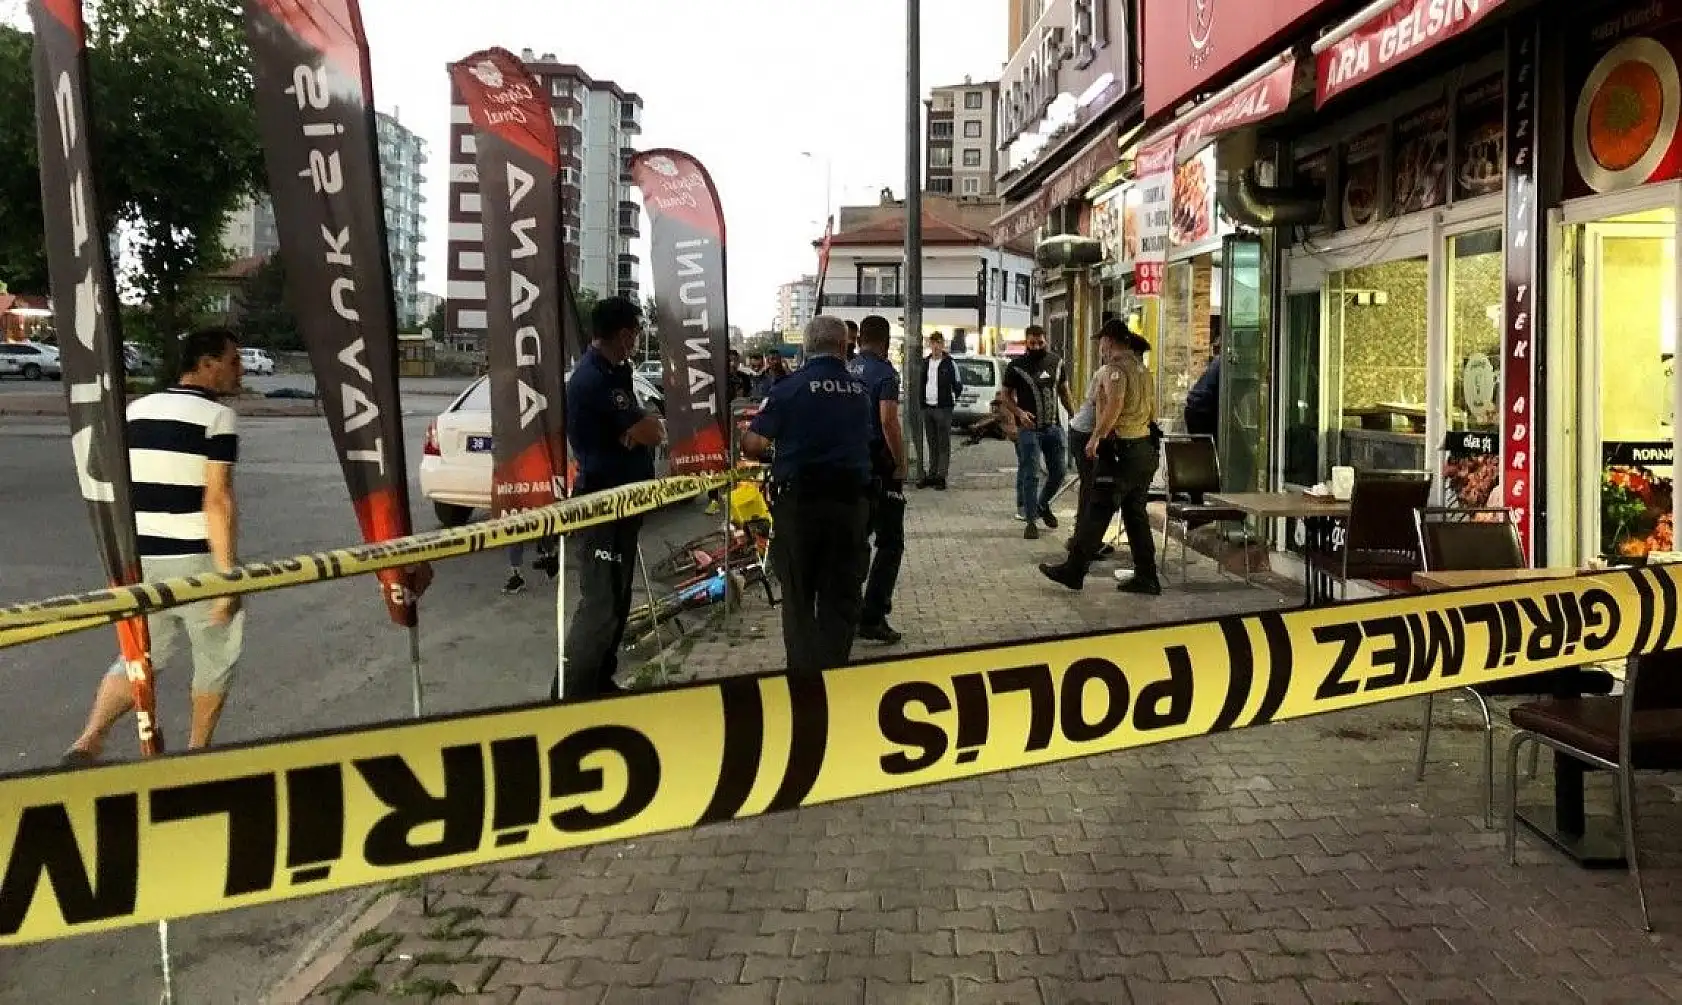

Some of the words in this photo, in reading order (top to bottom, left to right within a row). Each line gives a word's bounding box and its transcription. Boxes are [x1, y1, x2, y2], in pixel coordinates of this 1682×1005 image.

[1325, 40, 1370, 94] ARA
[1513, 284, 1528, 358] TEK
[1510, 395, 1526, 537] ADRES
[594, 548, 622, 563] POL
[1312, 587, 1621, 701] GİRİLMEZ
[877, 644, 1194, 775] POLİS
